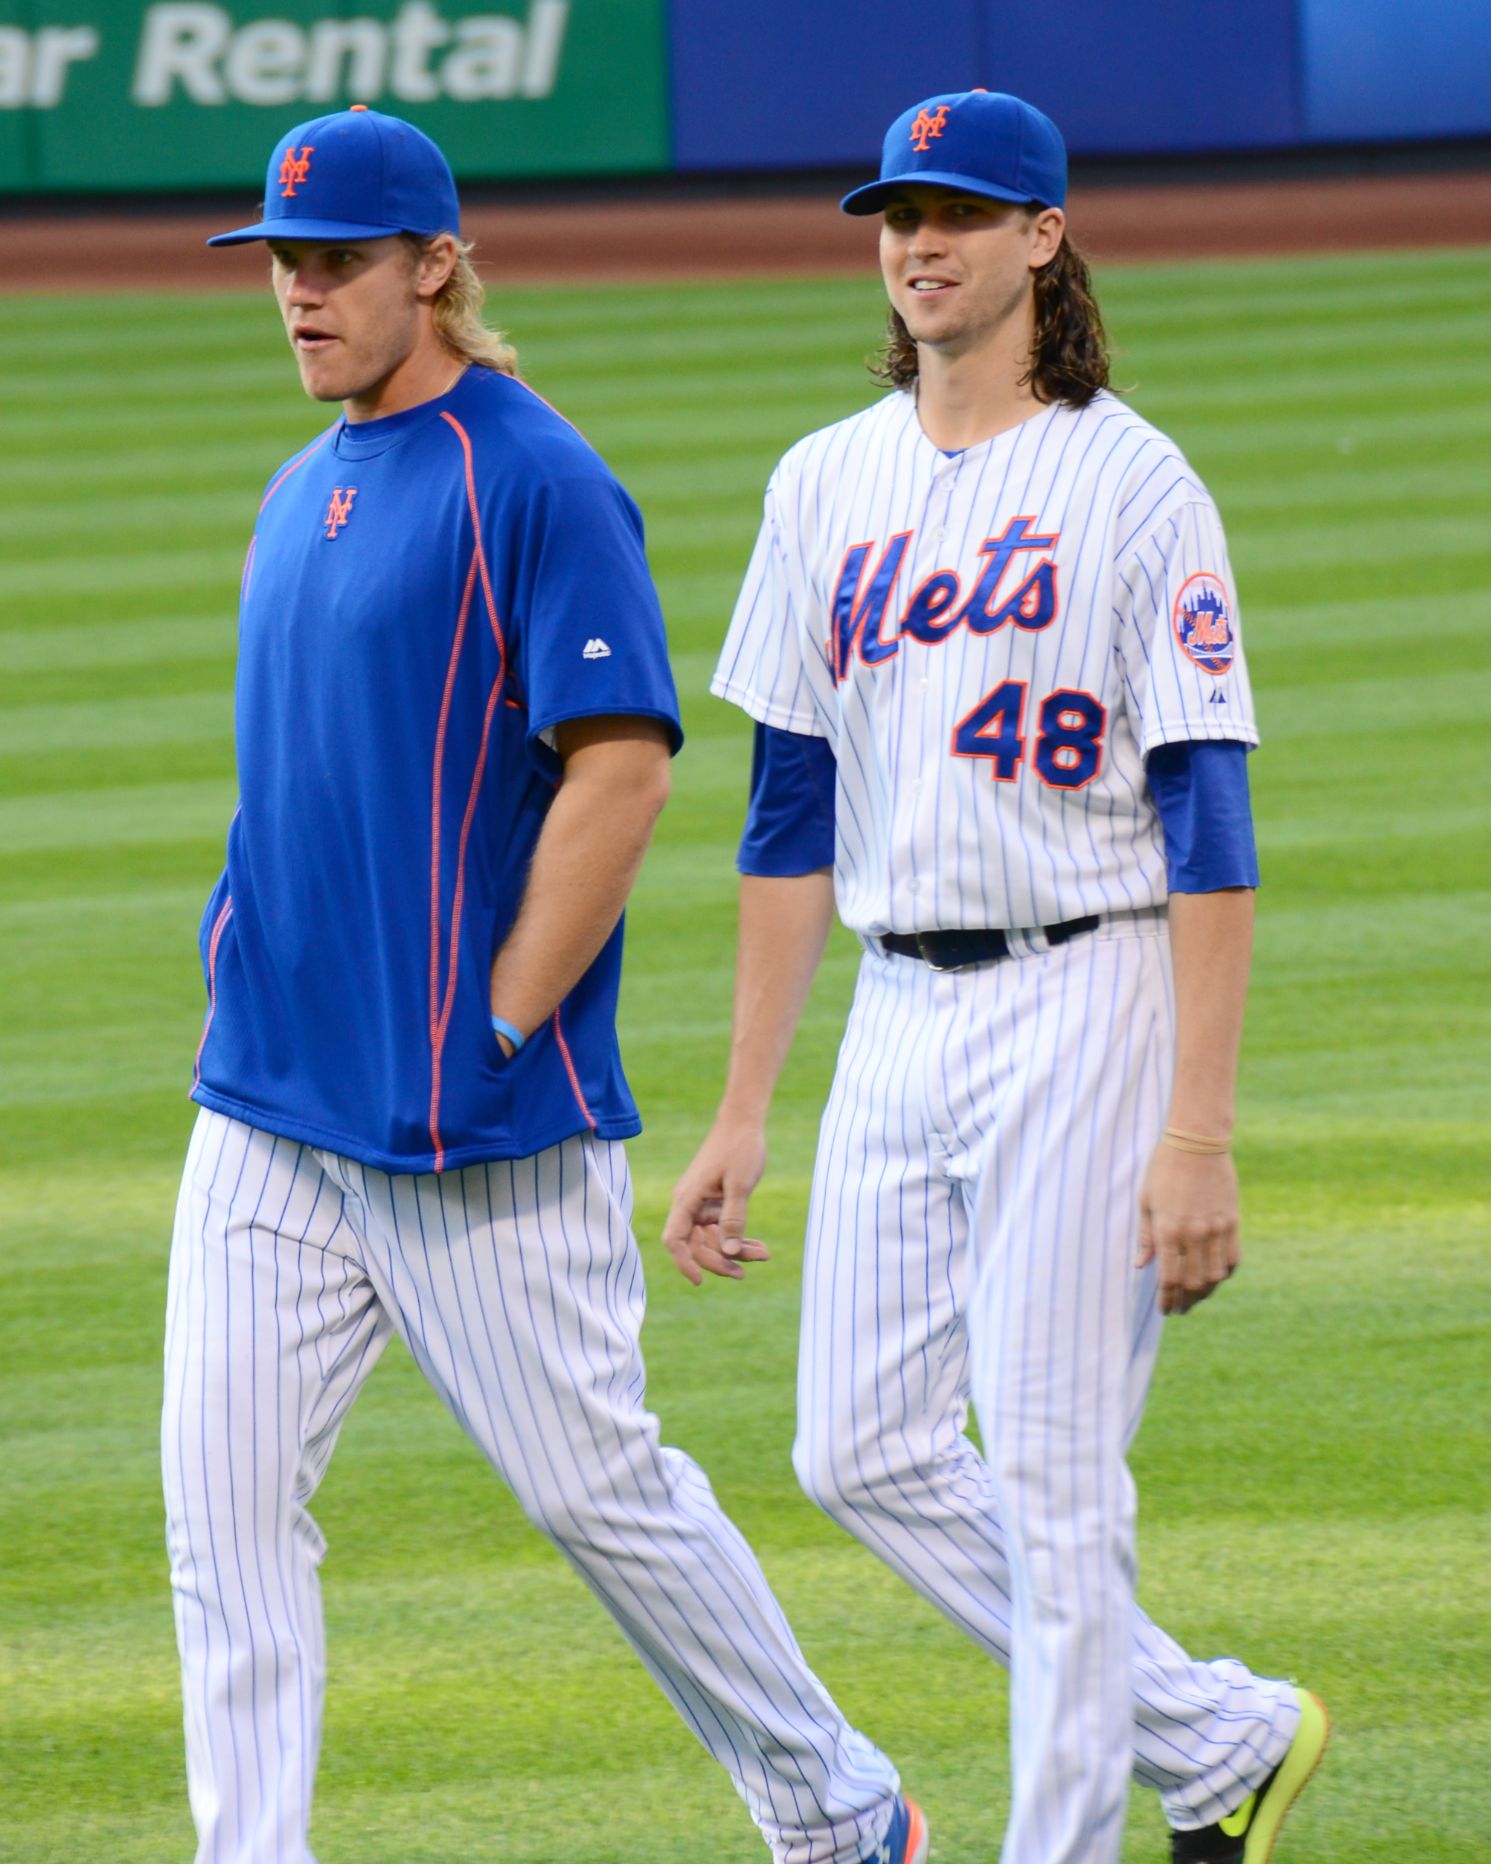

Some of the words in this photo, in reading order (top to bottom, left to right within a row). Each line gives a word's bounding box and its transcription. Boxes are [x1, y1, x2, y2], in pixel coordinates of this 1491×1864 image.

[133, 0, 566, 105] Rental
[826, 515, 1060, 690] Mets
[950, 679, 1107, 791] 48
